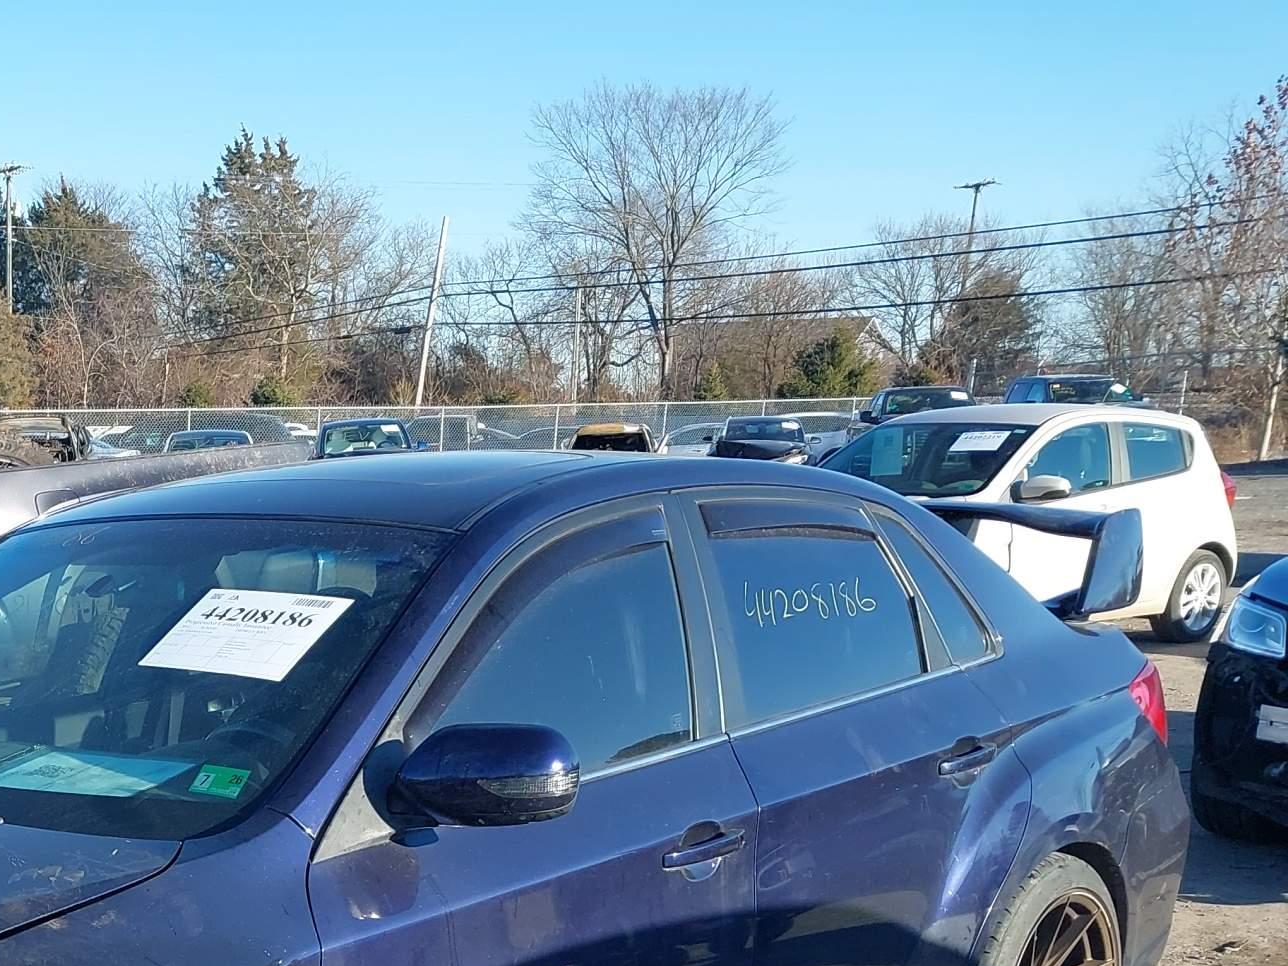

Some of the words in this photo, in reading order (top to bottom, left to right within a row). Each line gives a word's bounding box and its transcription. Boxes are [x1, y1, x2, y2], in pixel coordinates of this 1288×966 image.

[744, 576, 876, 628] 44208186
[200, 606, 320, 628] 44208186
[199, 774, 211, 786] 7
[228, 774, 244, 785] 26
